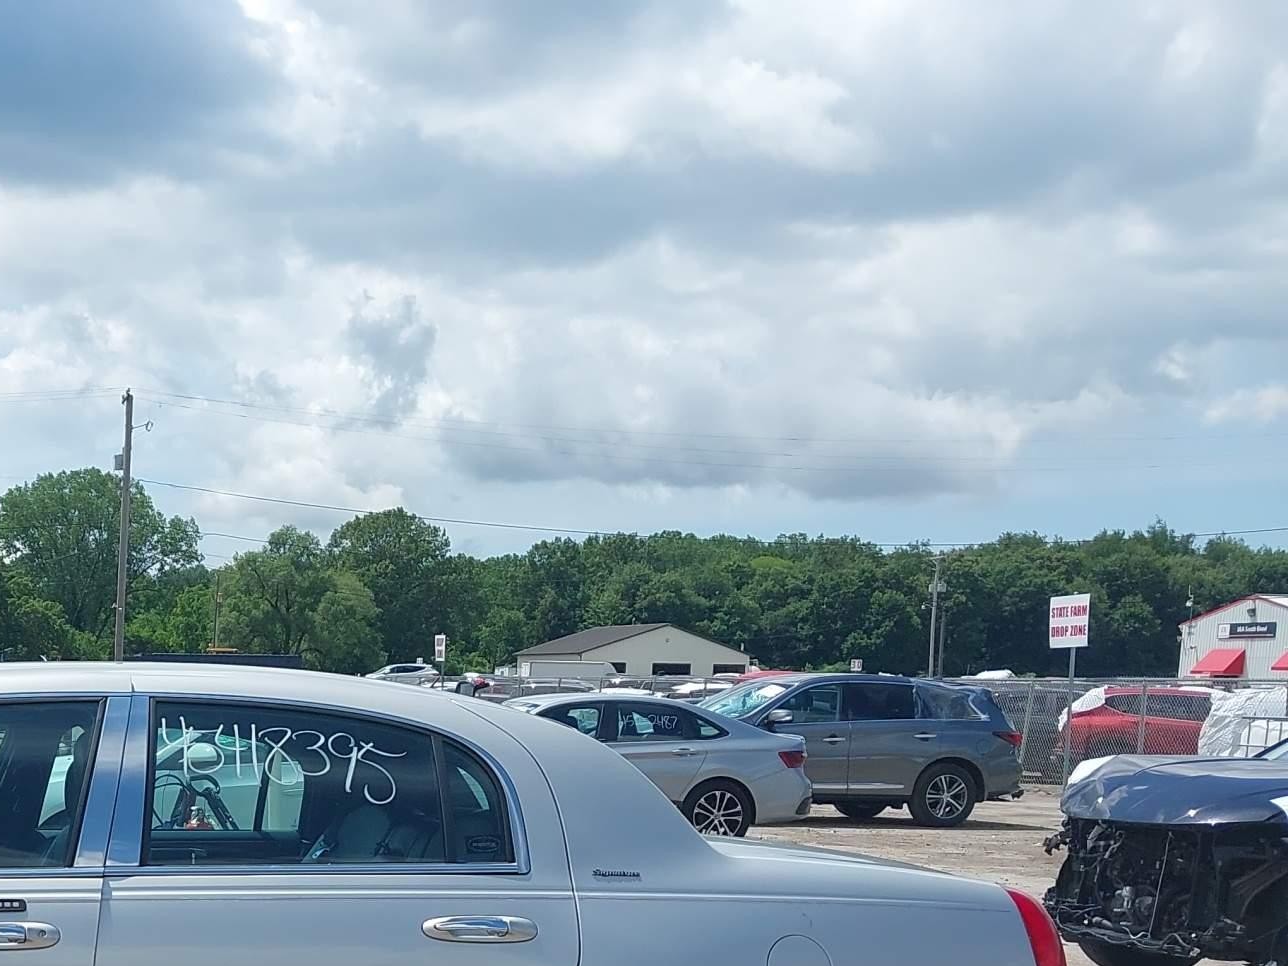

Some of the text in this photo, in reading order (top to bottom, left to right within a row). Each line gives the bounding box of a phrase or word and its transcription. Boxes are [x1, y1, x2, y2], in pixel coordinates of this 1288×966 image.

[1051, 604, 1088, 618] STATE FARM
[1051, 623, 1087, 638] DROP ZONE
[161, 715, 408, 806] 45418395
